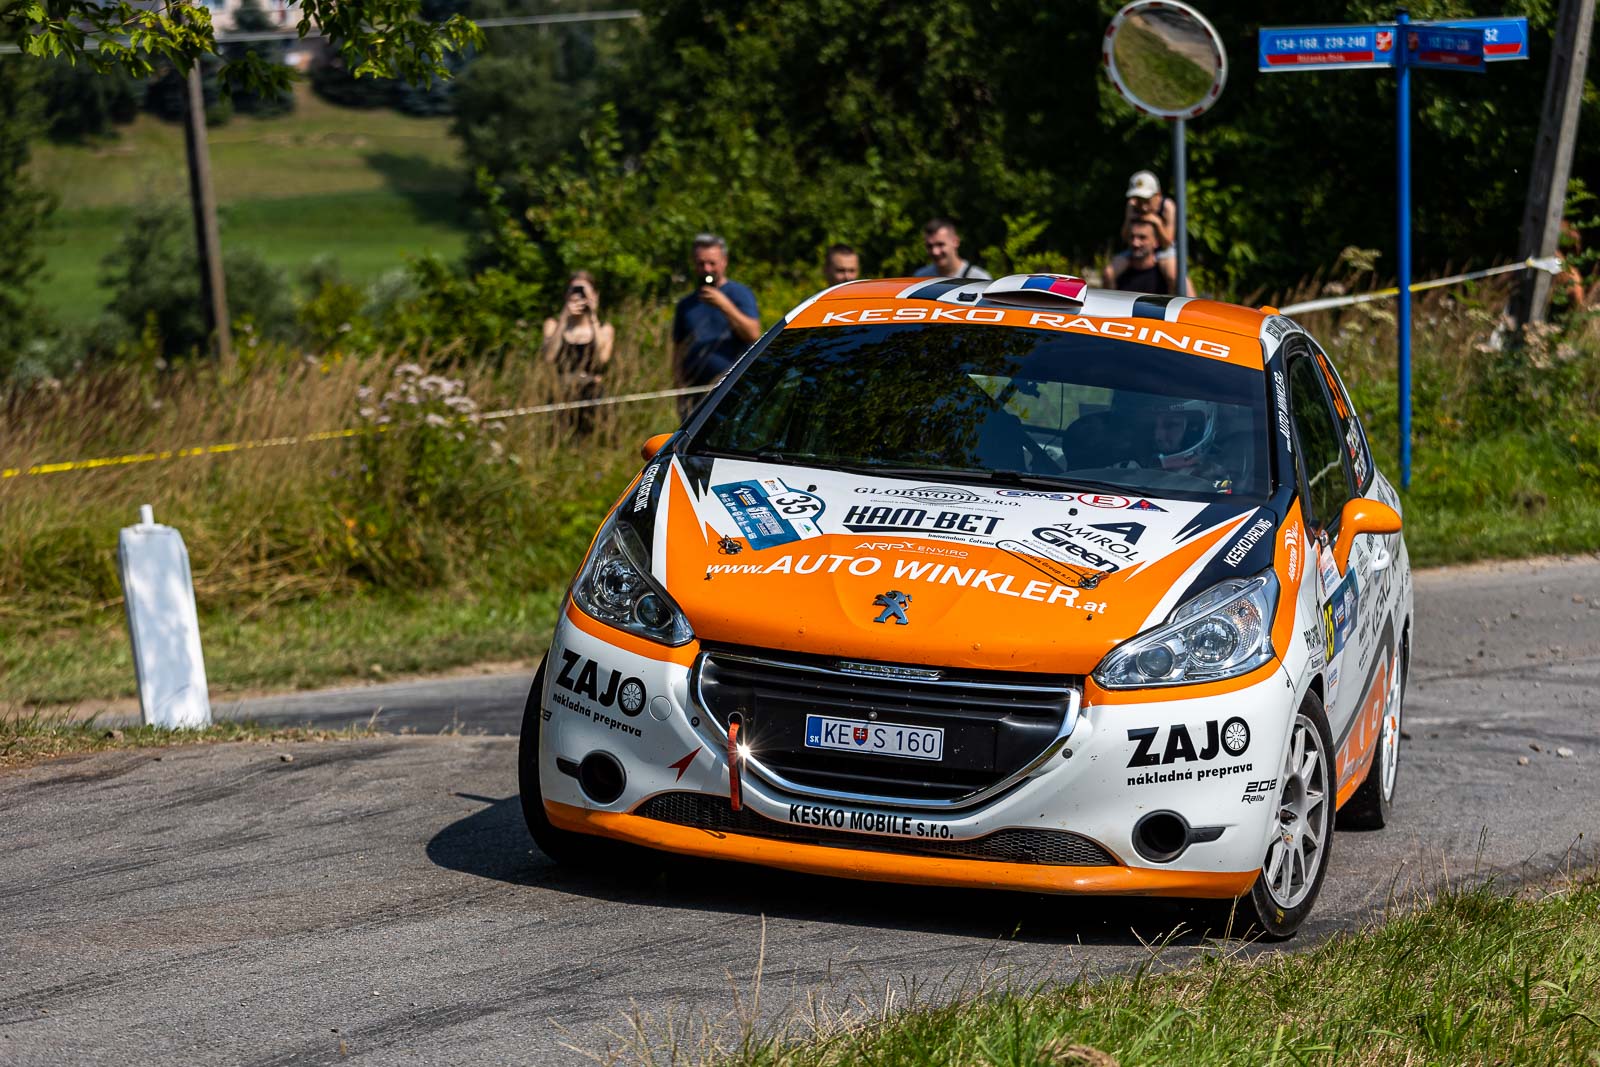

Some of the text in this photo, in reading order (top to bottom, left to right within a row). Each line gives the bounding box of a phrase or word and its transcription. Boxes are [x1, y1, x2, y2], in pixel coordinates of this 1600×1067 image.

[822, 308, 1004, 325] KESKO
[1029, 312, 1231, 359] RACING
[776, 496, 819, 515] 35
[853, 487, 980, 503] GLOBWOOD
[843, 505, 1005, 535] KAM-BET
[1031, 526, 1120, 574] Green
[1053, 522, 1139, 562] AMIROL
[1223, 518, 1273, 568] KESKO RACING
[556, 648, 647, 718] ZAJO
[553, 692, 591, 717] nákladná
[593, 711, 642, 738] preprava
[809, 735, 820, 743] SK
[824, 722, 852, 745] KE
[1126, 716, 1251, 769] ZAJO
[1127, 762, 1253, 786] nákladná preprava
[1241, 794, 1266, 805] Rally
[788, 803, 954, 839] KESKO MOBILE s.r.o.
